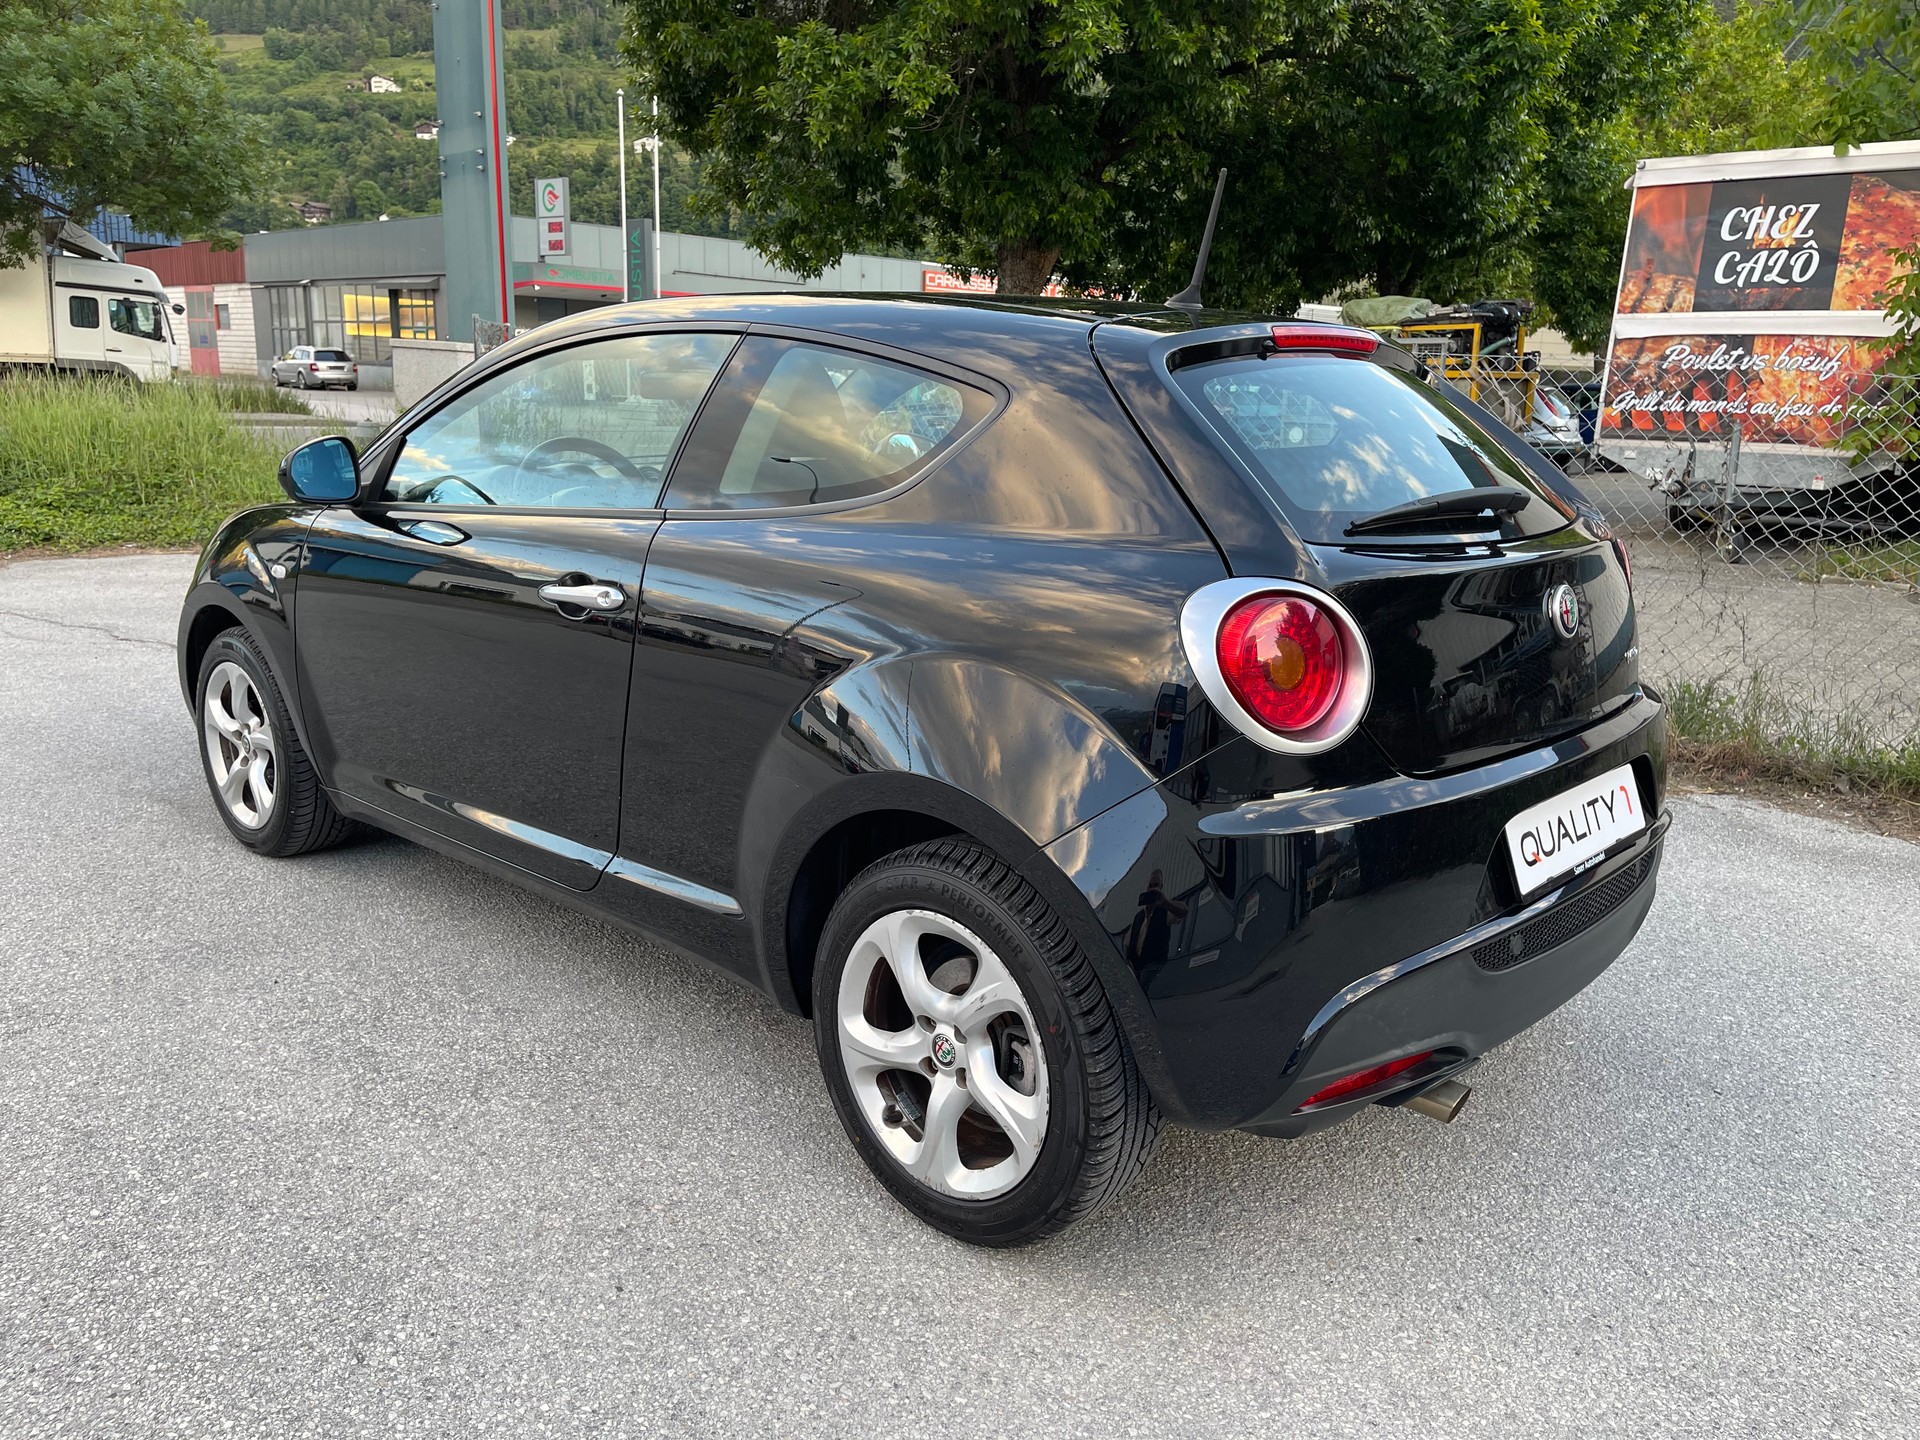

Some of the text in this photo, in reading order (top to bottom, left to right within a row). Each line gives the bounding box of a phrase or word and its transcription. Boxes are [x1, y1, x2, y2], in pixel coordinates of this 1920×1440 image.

[1721, 204, 1821, 241] CHEZ
[1714, 240, 1820, 287] CALÔ
[1662, 344, 1744, 371] Poulet
[1740, 353, 1770, 371] vs
[1611, 390, 1664, 416] Grill
[1660, 391, 1685, 412] du
[1686, 392, 1748, 414] monde
[1750, 403, 1777, 415] au
[1774, 394, 1814, 422] feu
[1520, 785, 1632, 867] QUALITY 1
[941, 883, 1024, 957] PERFORMER
